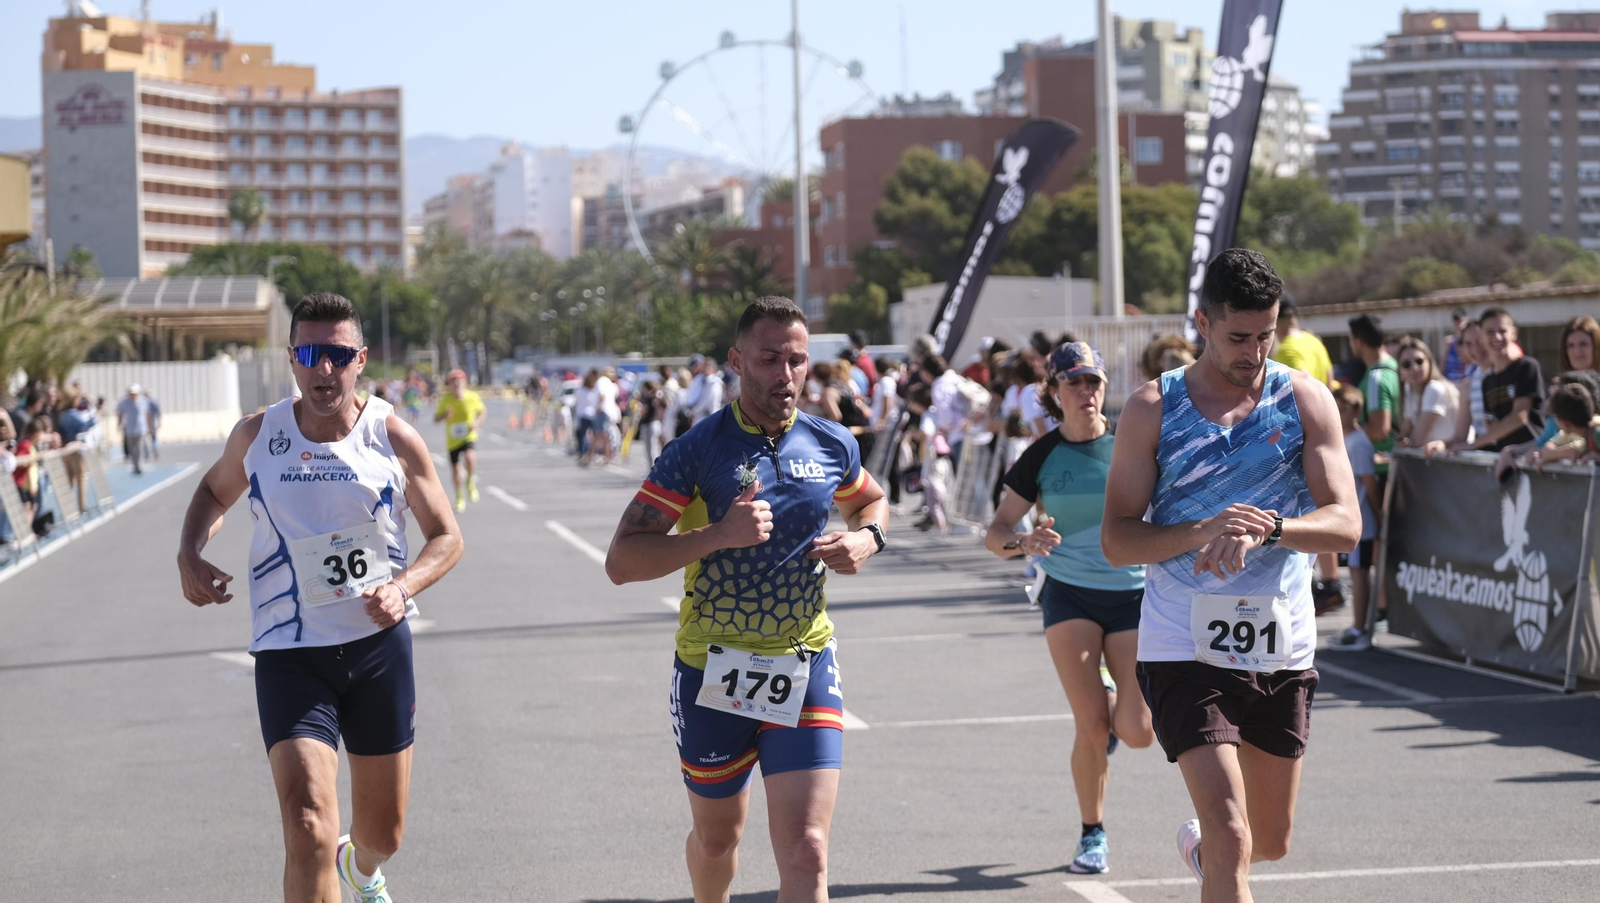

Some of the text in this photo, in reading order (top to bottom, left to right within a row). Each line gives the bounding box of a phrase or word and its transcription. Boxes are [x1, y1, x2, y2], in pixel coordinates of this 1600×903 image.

[280, 472, 359, 482] MARACENA
[789, 459, 826, 478] bida
[323, 549, 368, 586] 36
[1396, 555, 1515, 614] aquéatacamos
[1207, 620, 1277, 654] 291
[721, 668, 792, 705] 179
